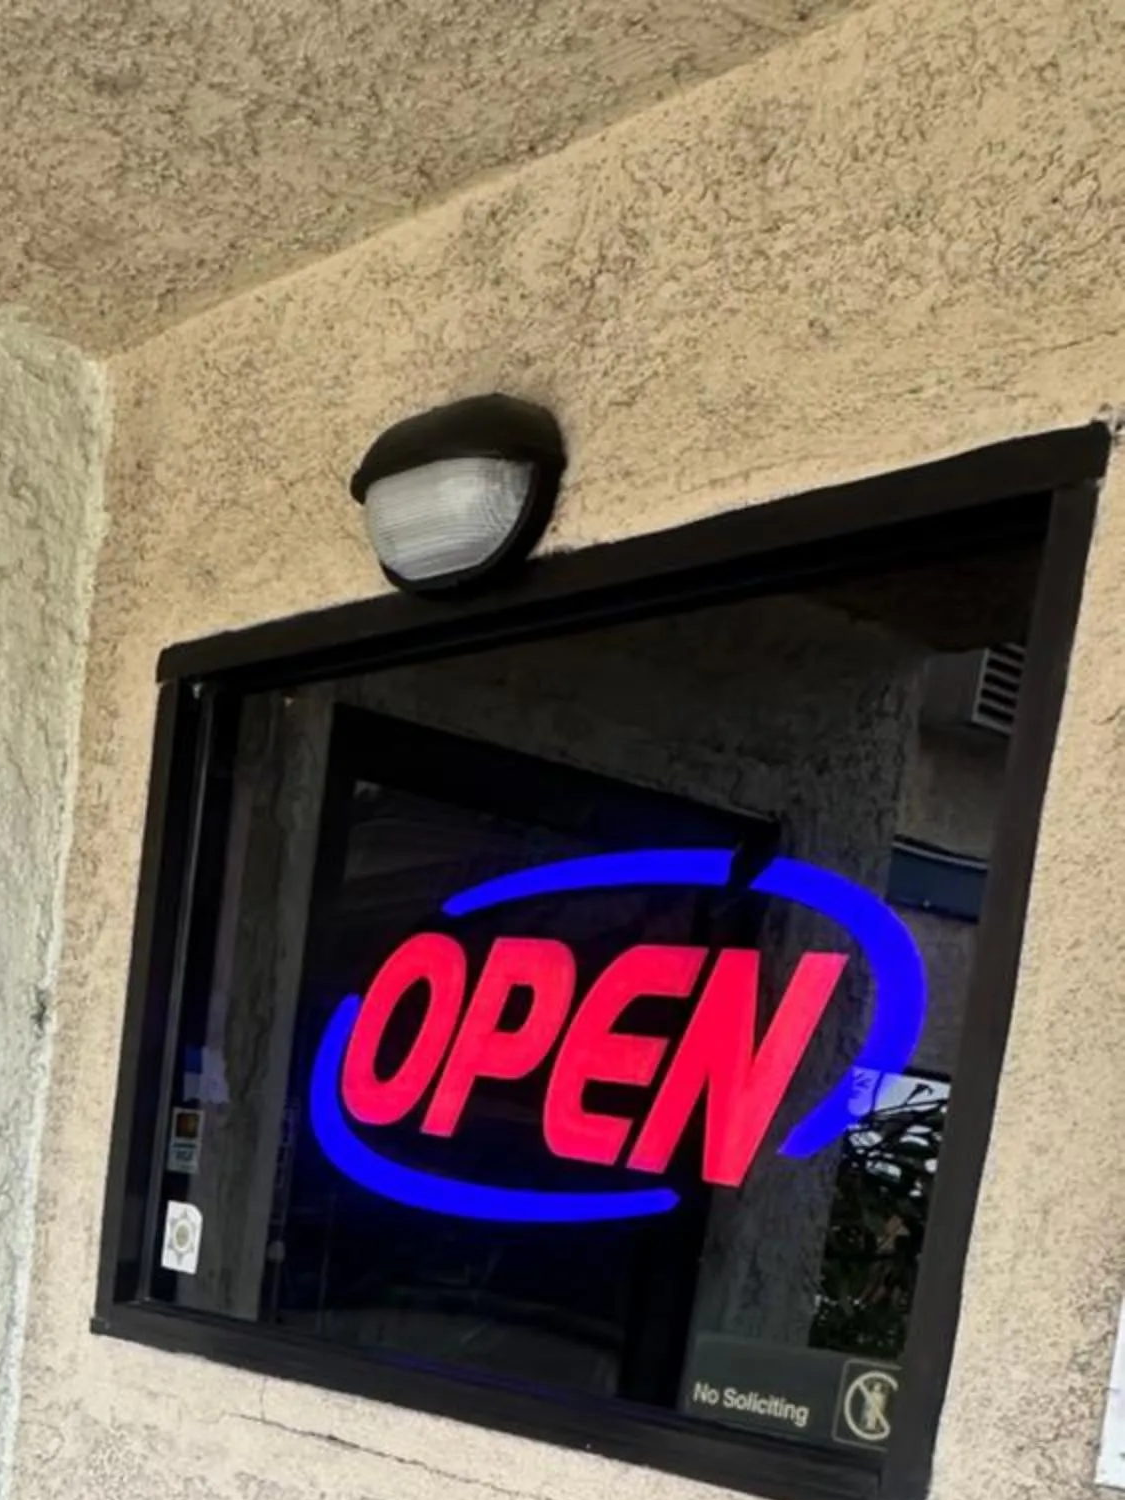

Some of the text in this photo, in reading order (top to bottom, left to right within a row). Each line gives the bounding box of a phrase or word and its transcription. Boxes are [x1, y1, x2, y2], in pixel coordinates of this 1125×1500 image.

[341, 931, 849, 1188] OPEN
[693, 1381, 810, 1427] No Soliciting
